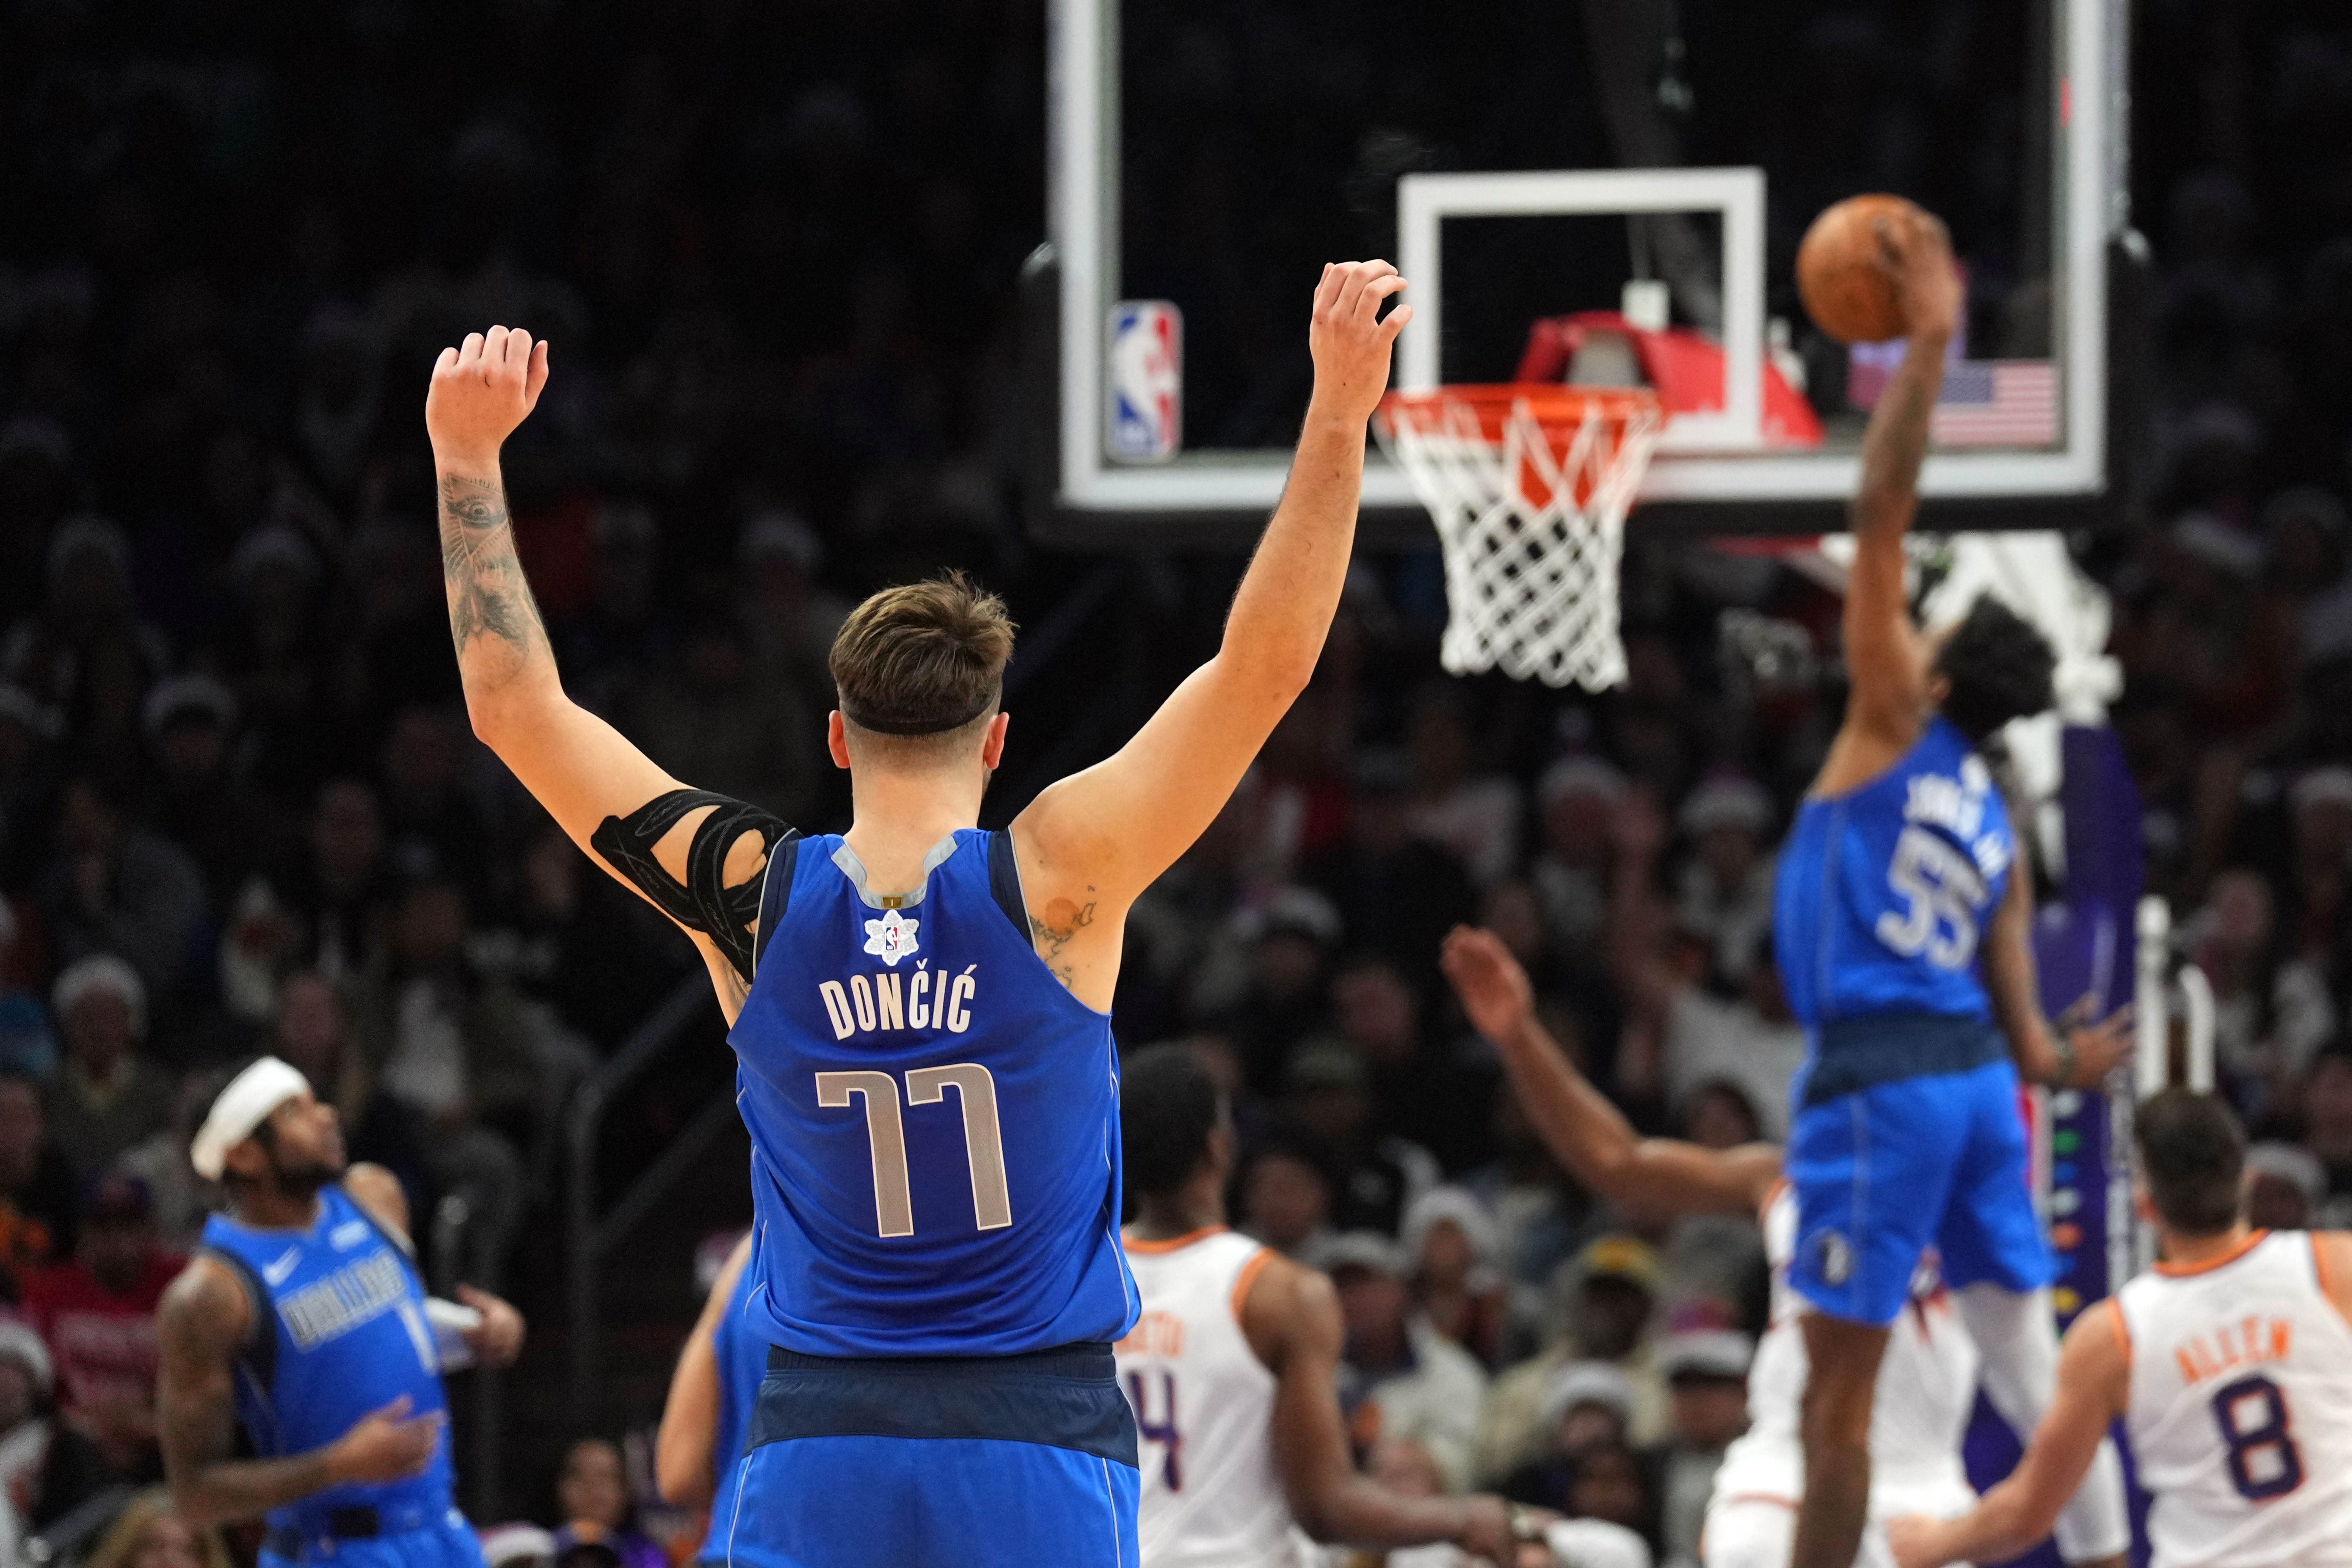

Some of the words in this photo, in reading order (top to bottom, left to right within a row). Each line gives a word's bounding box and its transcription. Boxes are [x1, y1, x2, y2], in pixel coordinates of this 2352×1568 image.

[1875, 826, 1988, 969] 55
[819, 958, 977, 1040] DONČIĆ
[815, 1063, 1012, 1238] 77
[396, 1298, 438, 1376] 1
[2175, 1315, 2293, 1385] ALLEN
[1128, 1368, 1182, 1492] 4
[2210, 1374, 2305, 1505] 8
